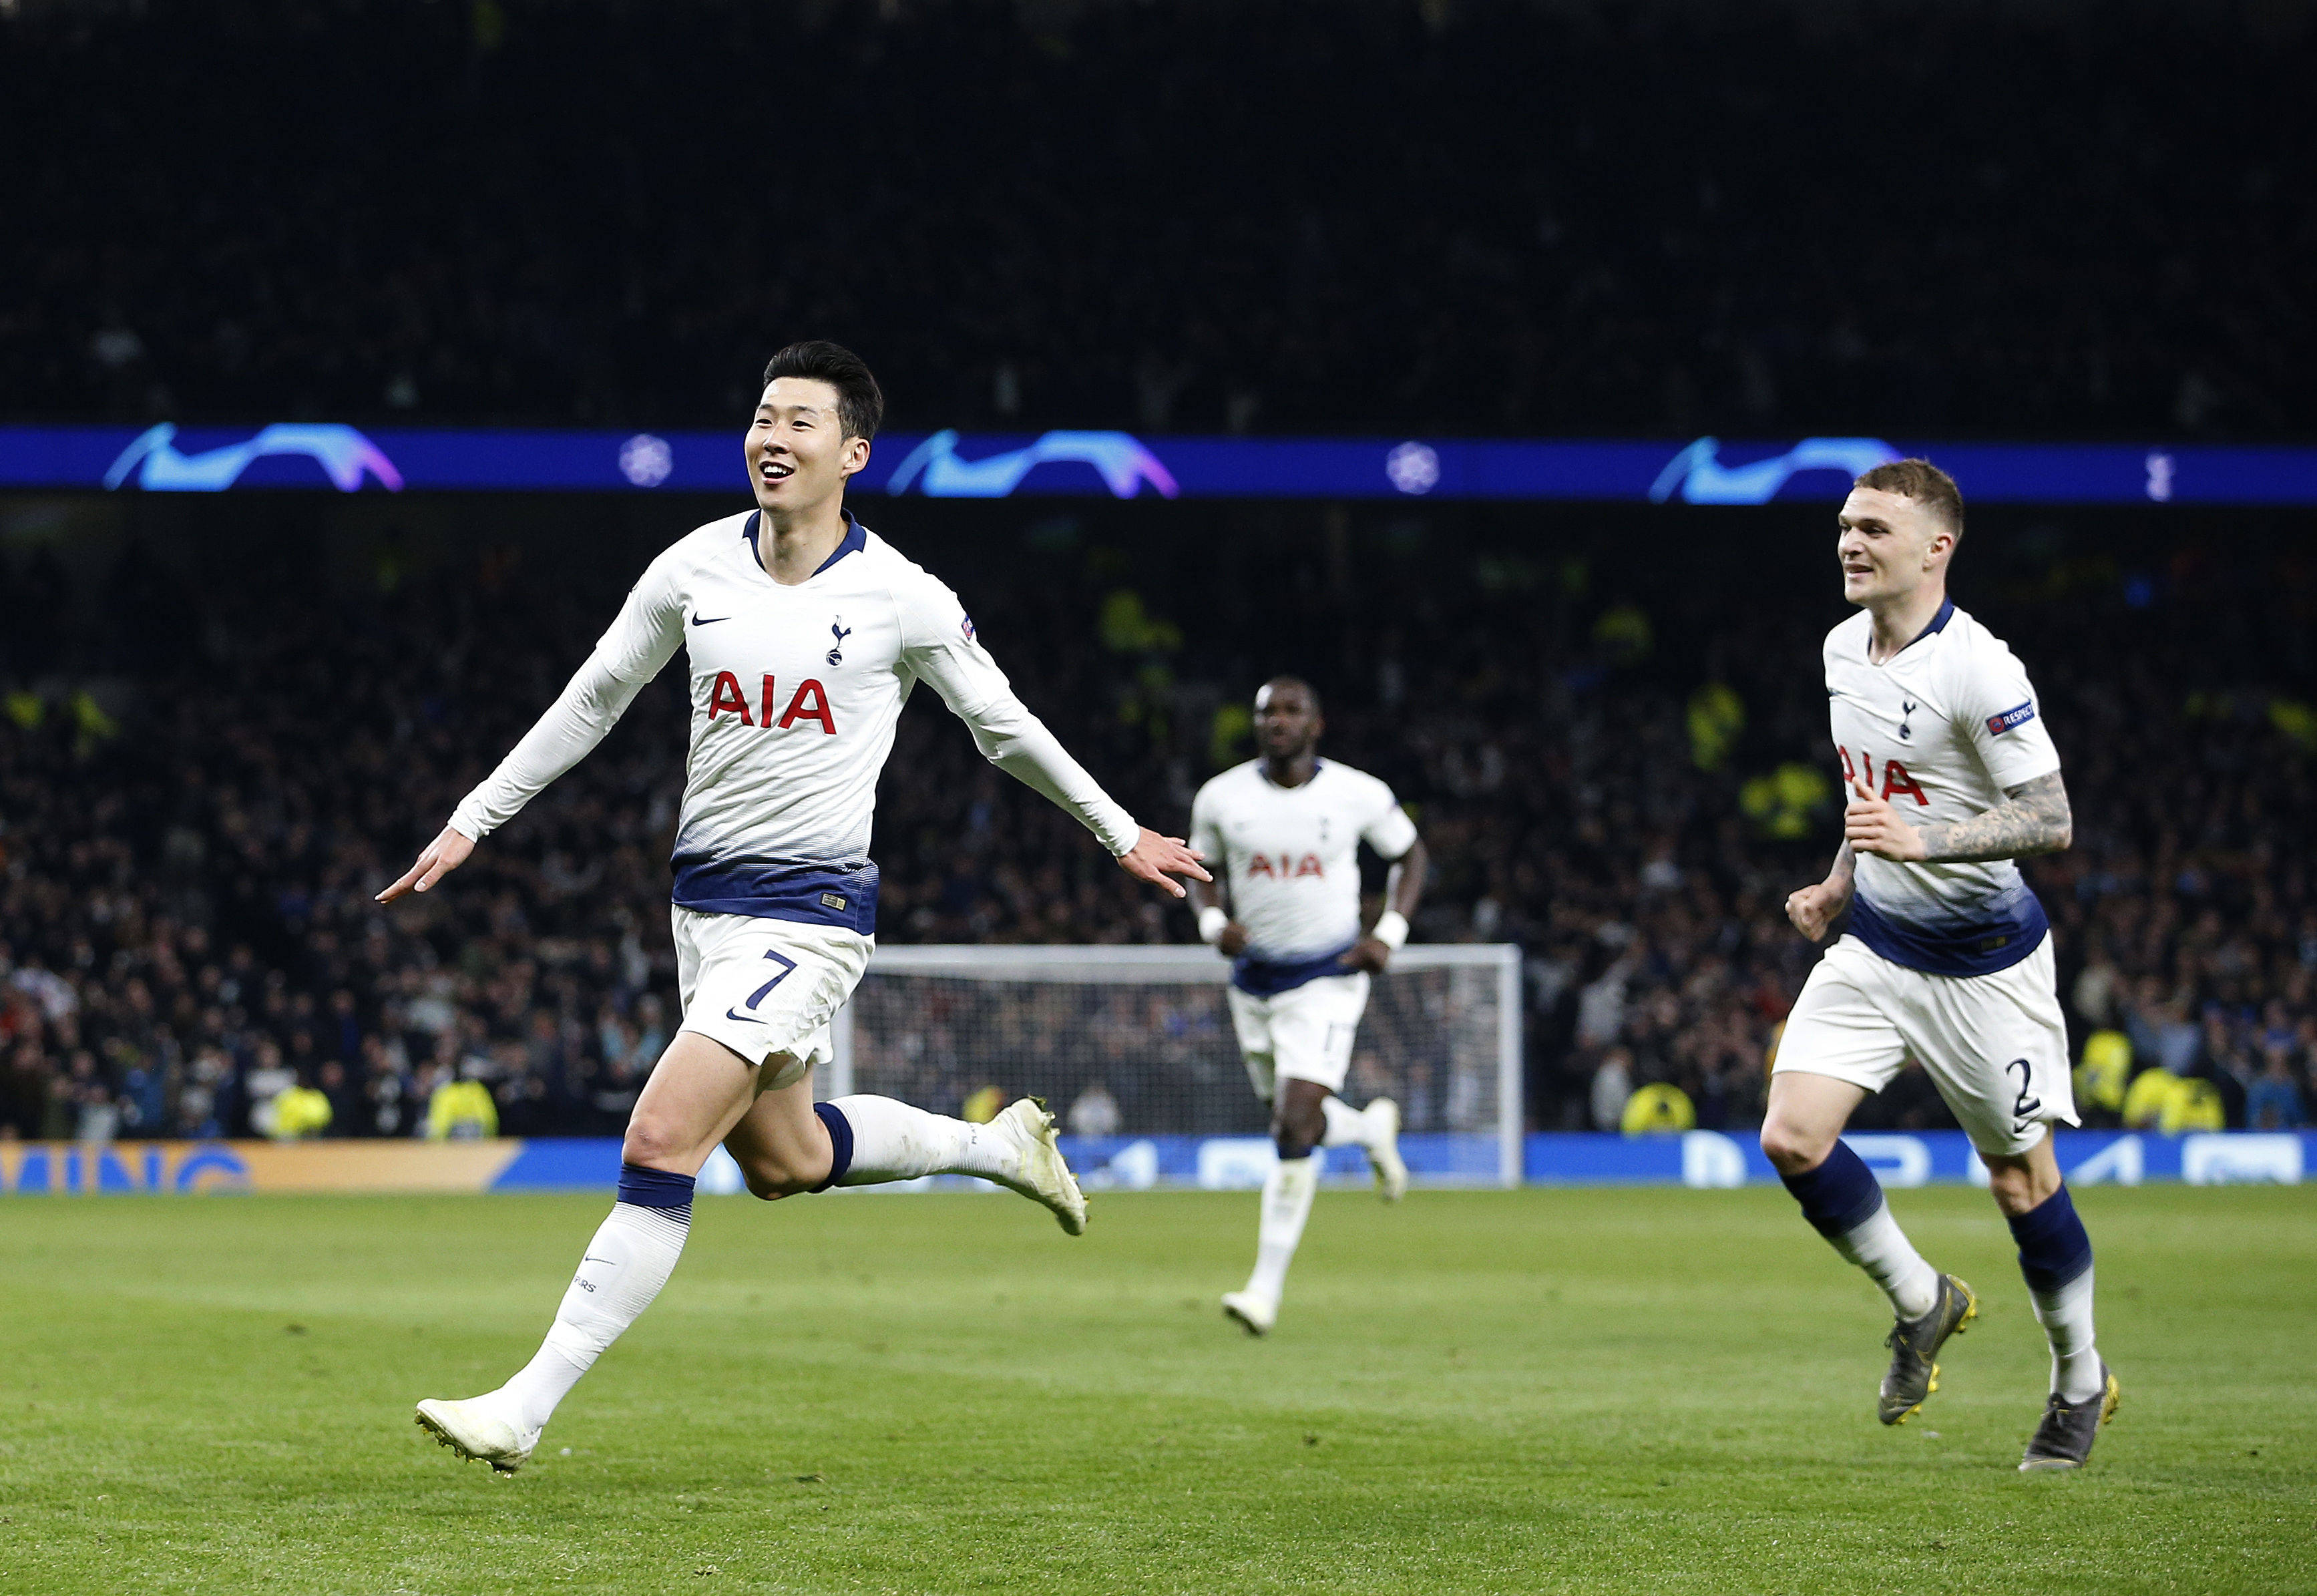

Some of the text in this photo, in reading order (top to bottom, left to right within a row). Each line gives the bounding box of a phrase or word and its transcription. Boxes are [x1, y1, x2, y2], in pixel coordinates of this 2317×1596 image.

[708, 671, 837, 735] AIA
[1247, 853, 1323, 878] AIA
[746, 949, 797, 1010] 7
[2005, 1058, 2041, 1117] 2
